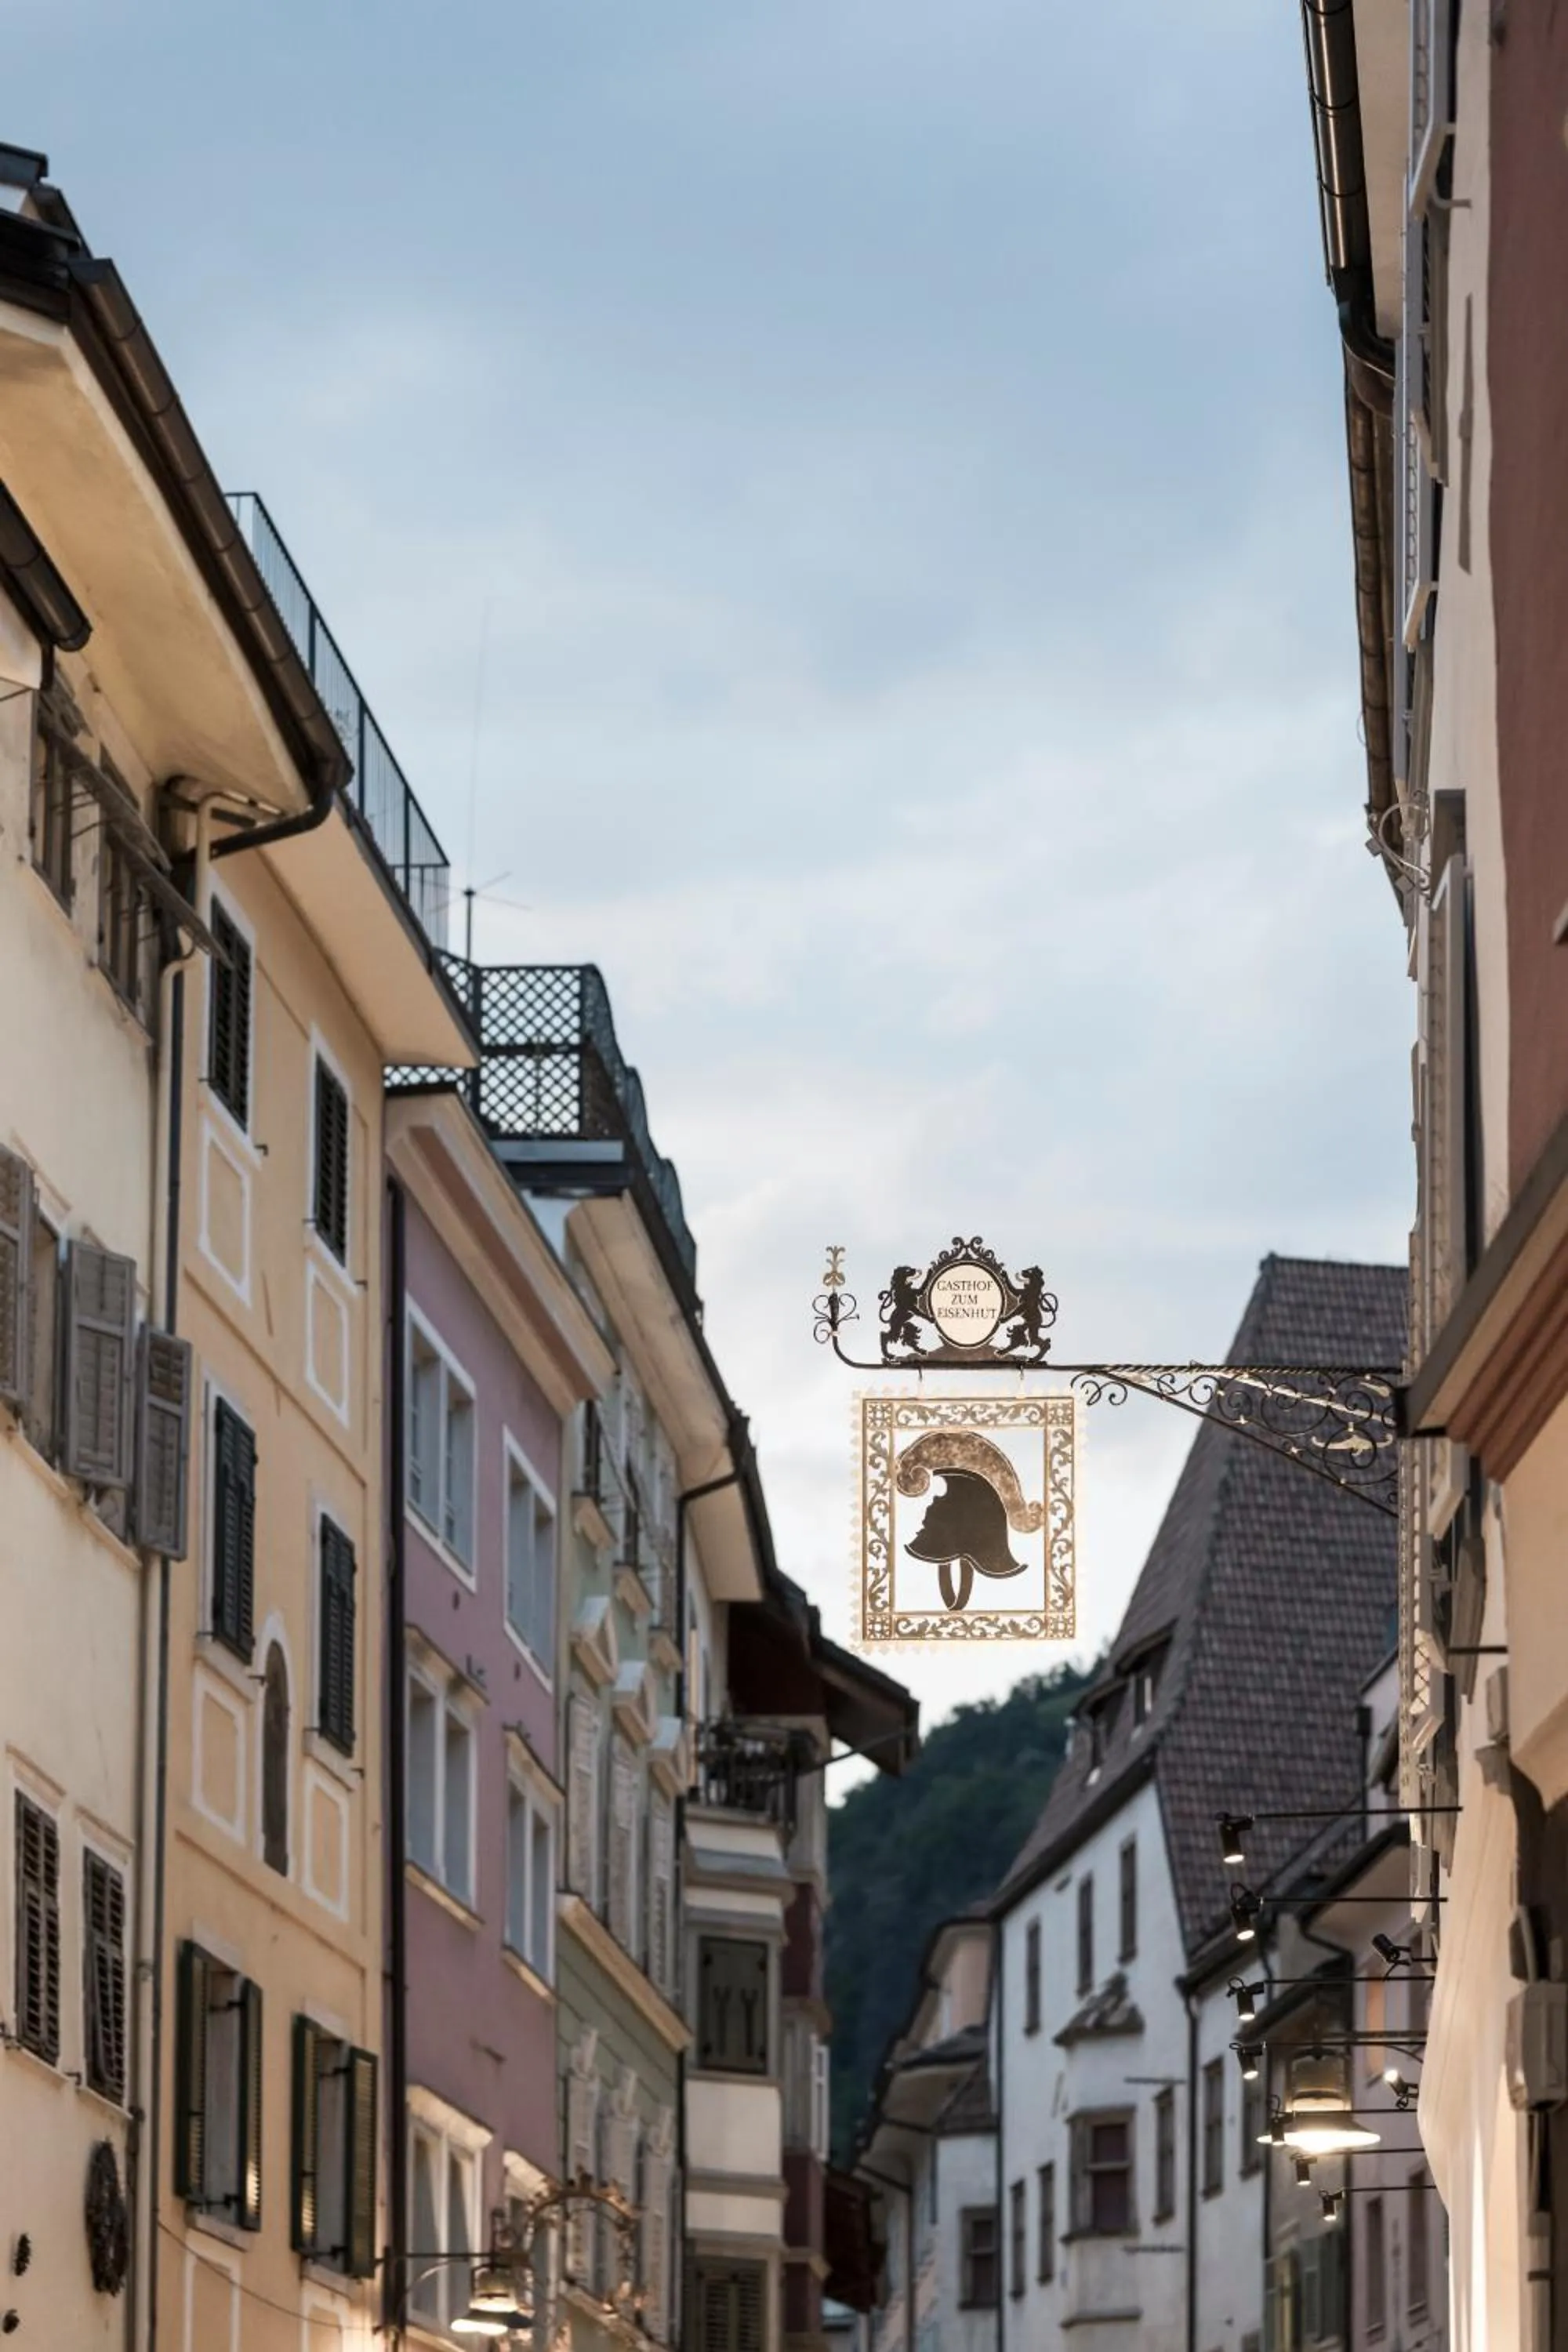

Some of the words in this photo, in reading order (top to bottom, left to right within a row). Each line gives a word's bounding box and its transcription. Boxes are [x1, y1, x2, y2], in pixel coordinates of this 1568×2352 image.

[937, 1280, 993, 1291] GASTHOF
[951, 1294, 978, 1305] ZUM
[937, 1308, 996, 1319] EISENHUT
